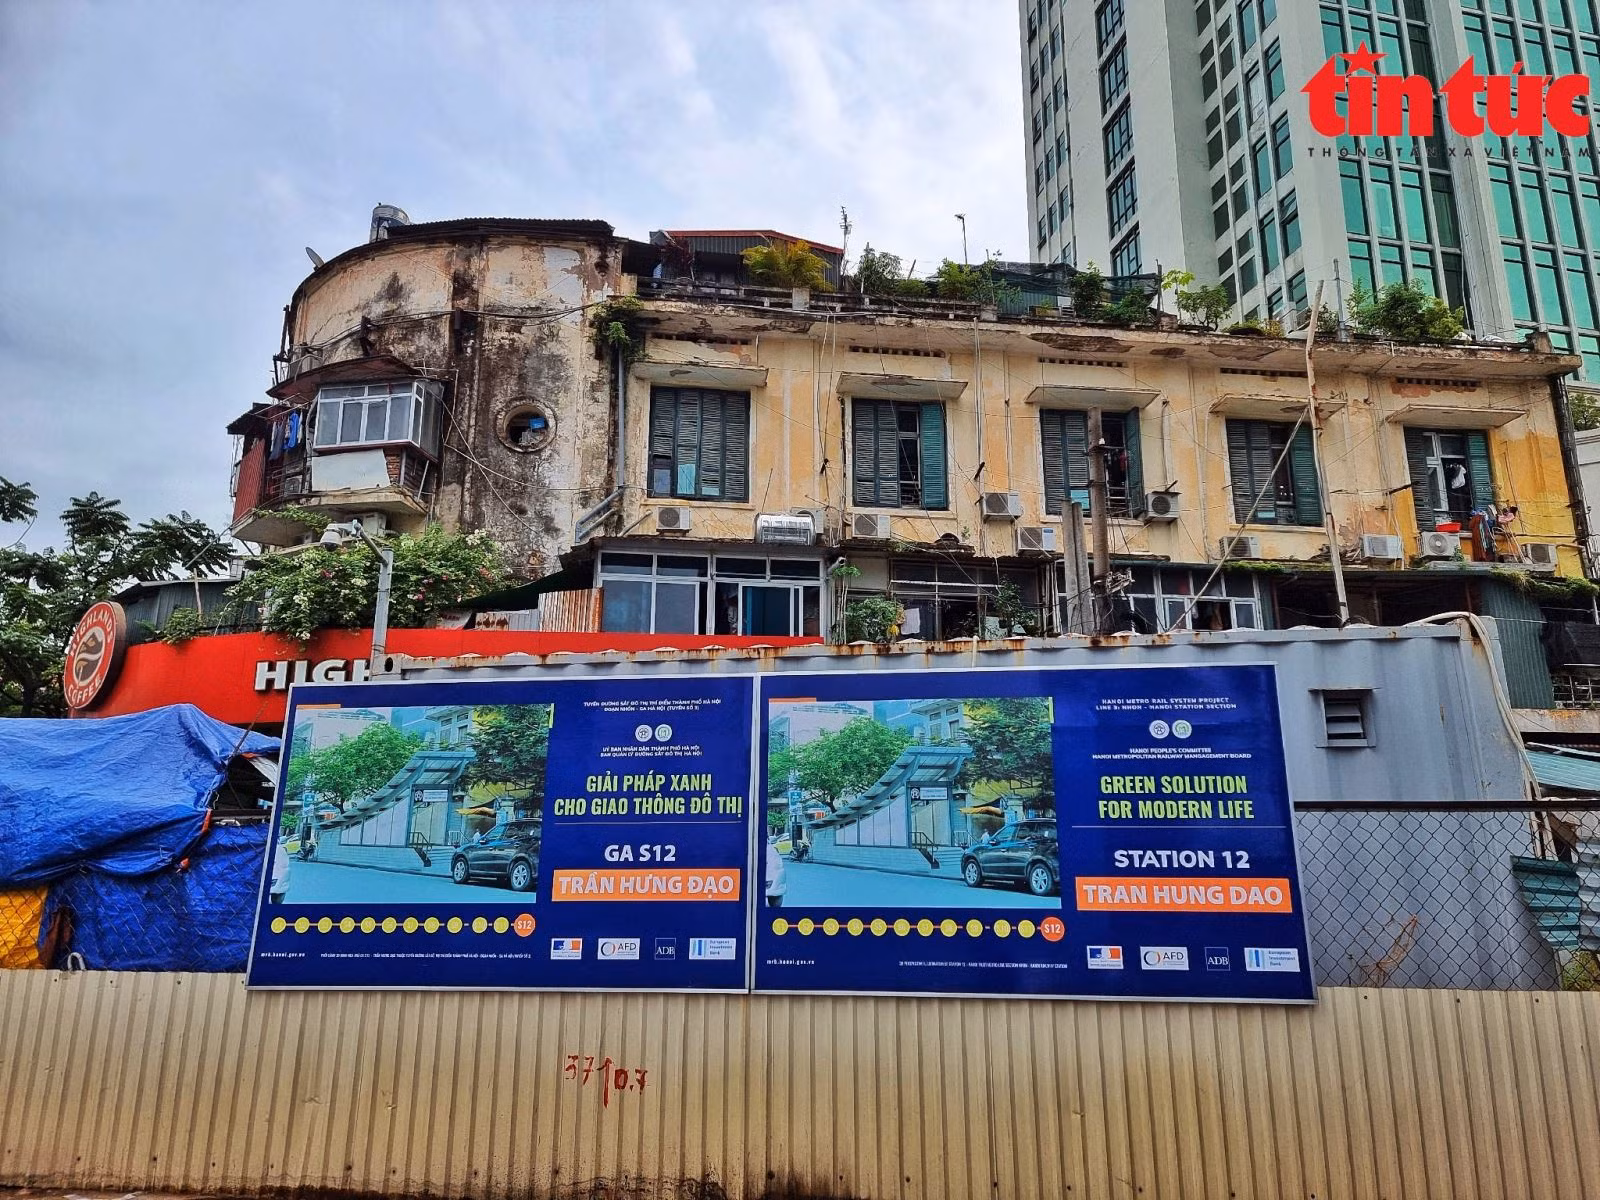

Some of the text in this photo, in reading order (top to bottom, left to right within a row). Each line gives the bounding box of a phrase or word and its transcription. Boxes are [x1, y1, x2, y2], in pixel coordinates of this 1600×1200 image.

[68, 673, 101, 705] COFFEE
[586, 770, 712, 792] GIẢI PHÁP XANH
[1100, 775, 1248, 794] GREEN SOLUTION
[554, 791, 742, 818] CHO GIAO THÔNG ĐÔ THỊ
[1098, 800, 1255, 819] FOR MODERN LIFE
[604, 844, 676, 862] GA S12
[1114, 849, 1250, 869] STATION 12
[559, 871, 734, 899] TRẦN HƯNG ĐẠO
[1082, 884, 1283, 906] TRAN HUNG DAO
[517, 921, 532, 931] S12
[1044, 923, 1061, 934] S12
[617, 942, 637, 951] AFD
[1162, 951, 1184, 960] AFD
[1207, 956, 1229, 965] ADB
